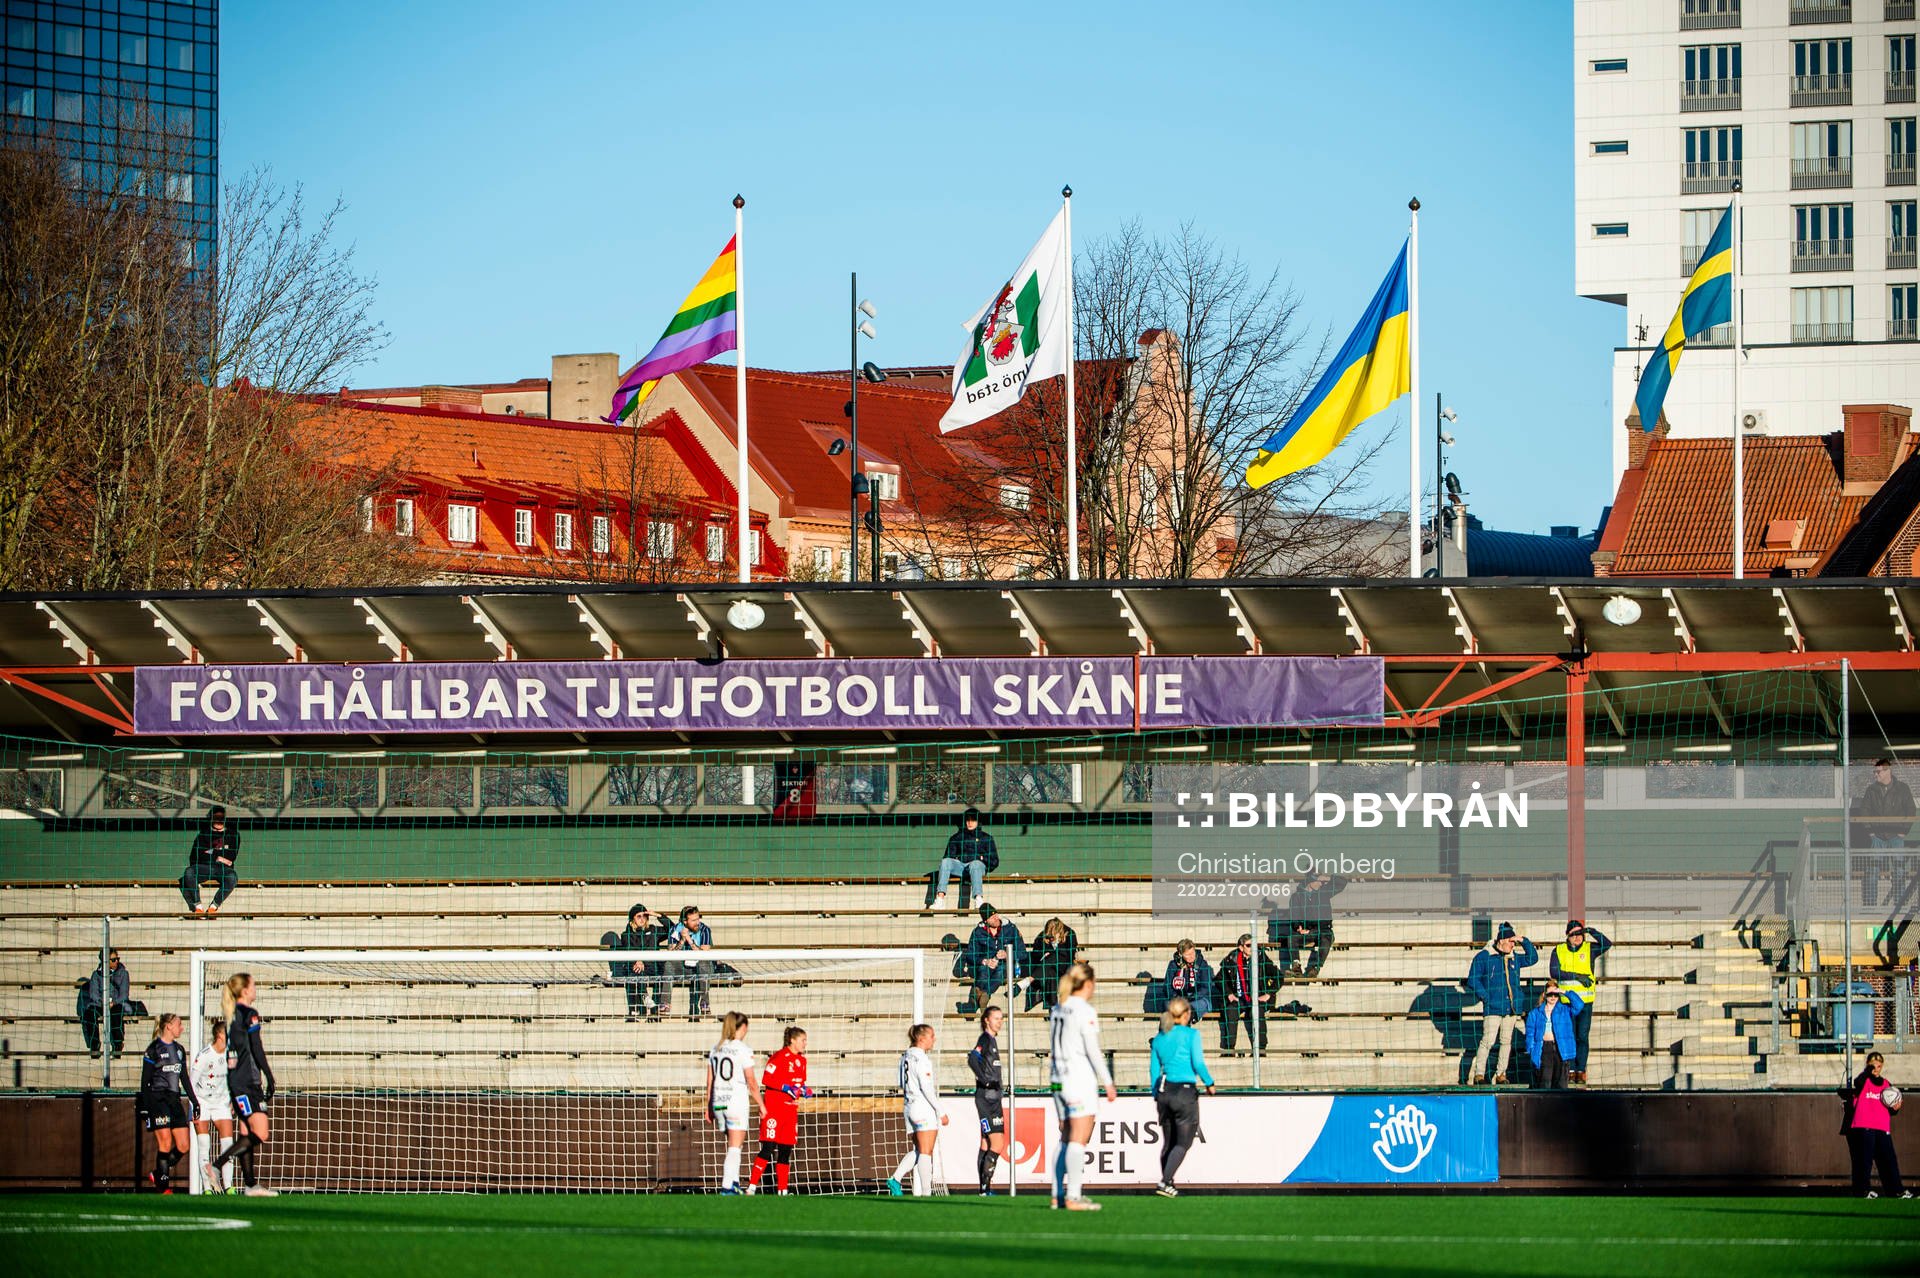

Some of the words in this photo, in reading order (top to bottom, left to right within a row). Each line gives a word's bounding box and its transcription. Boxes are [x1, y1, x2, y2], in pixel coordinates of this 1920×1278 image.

[170, 668, 279, 721] FÖR
[300, 666, 549, 720] HÅLLBAR
[566, 675, 939, 718] TJEJFOTBOLL
[959, 676, 971, 716] I
[992, 661, 1183, 716] SKÅNE
[789, 788, 801, 803] 8
[711, 1057, 734, 1081] 10
[766, 1128, 776, 1139] 18
[1082, 1151, 1135, 1174] PEL
